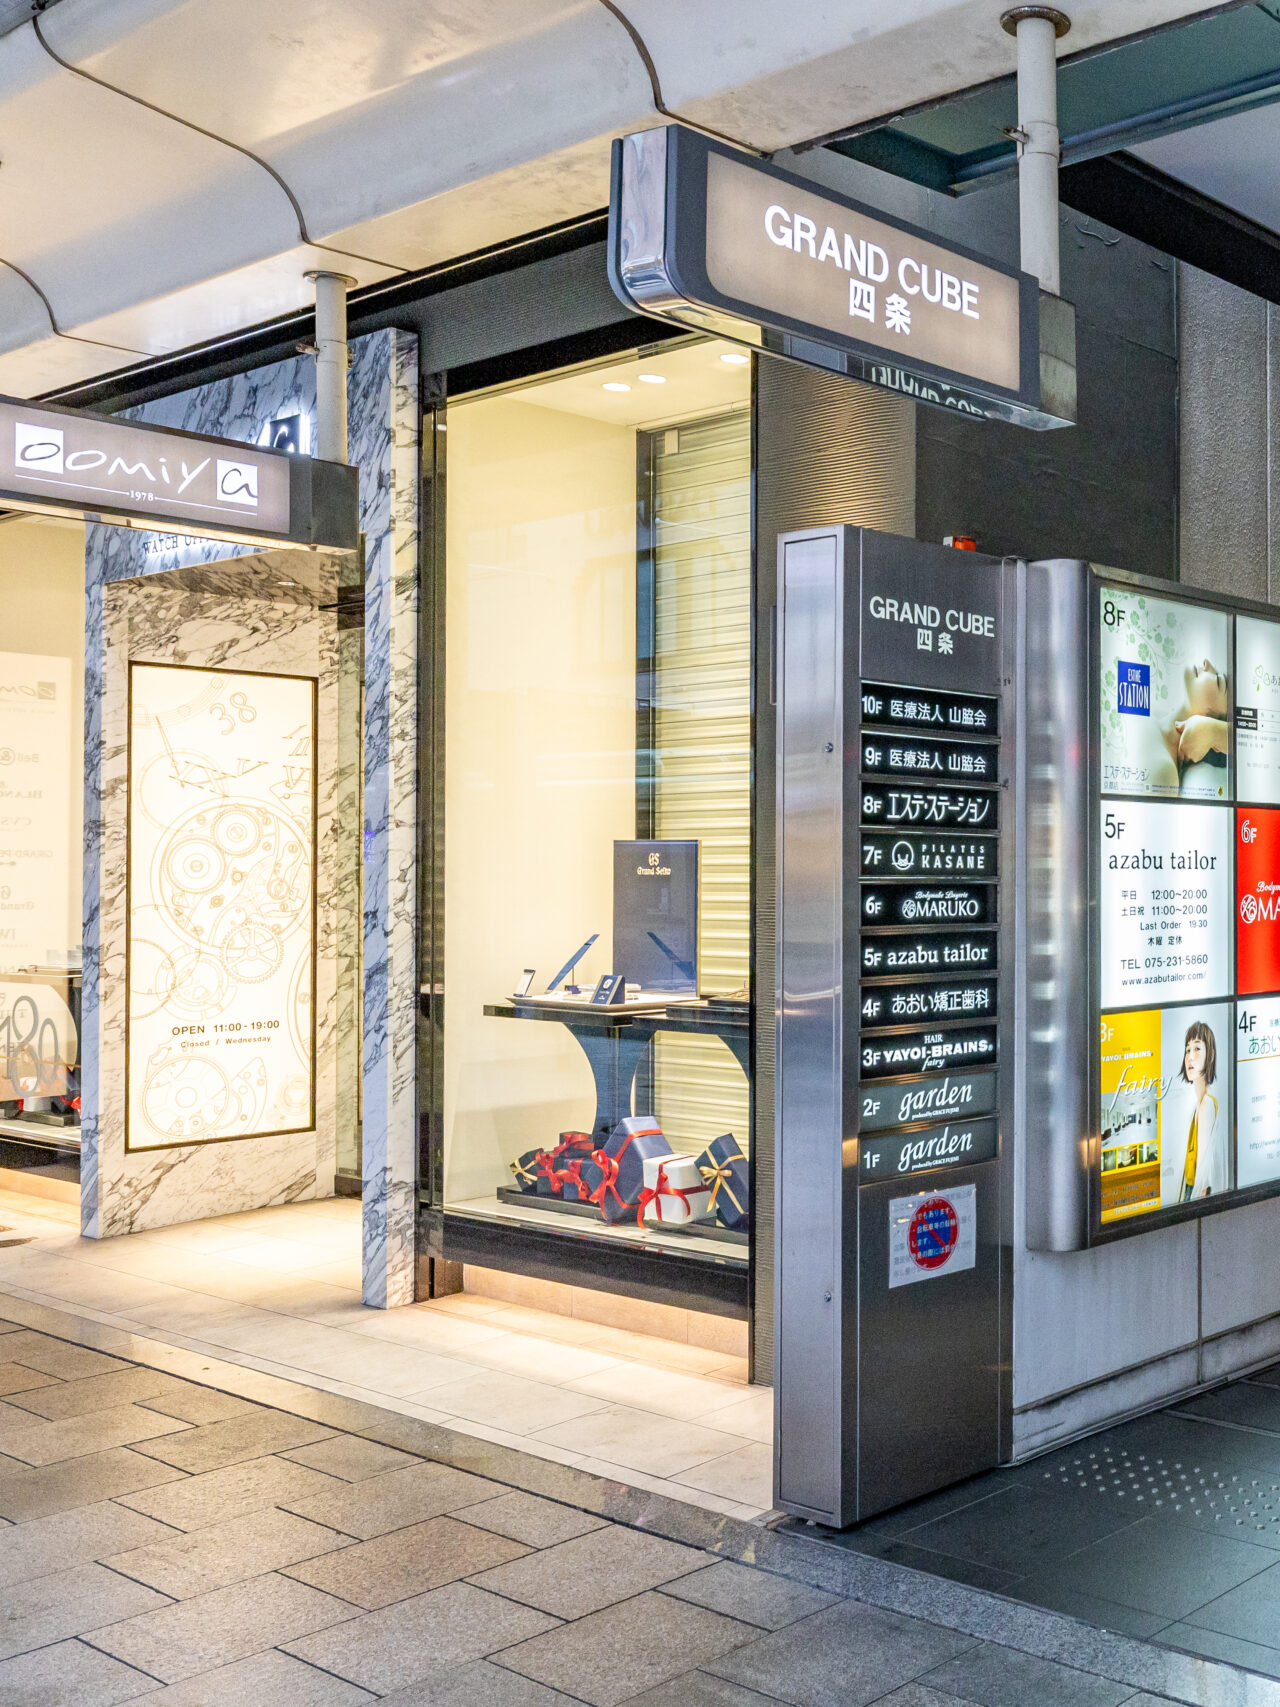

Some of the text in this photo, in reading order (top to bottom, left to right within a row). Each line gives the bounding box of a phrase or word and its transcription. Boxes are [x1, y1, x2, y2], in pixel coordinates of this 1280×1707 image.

[764, 204, 979, 320] GRAND CUBE
[848, 277, 912, 336] 四条
[129, 490, 154, 502] 1978
[142, 536, 178, 555] WATCH
[869, 596, 995, 637] GRAND CUBE
[1103, 600, 1125, 627] 8F
[917, 628, 954, 654] 四条
[1119, 682, 1149, 710] STATION
[861, 696, 987, 727] 10F 医療法人 山脇会
[865, 747, 986, 773] 9F 医療法人 山脇会
[863, 793, 989, 822] 8F エステ・ステーション
[1104, 813, 1125, 839] 5F
[1241, 820, 1258, 843] 6F
[863, 845, 882, 865] 7F
[921, 844, 985, 853] PILATES
[921, 855, 985, 869] KASANE
[1109, 849, 1217, 870] azabu tailor
[637, 866, 655, 875] Grand
[1121, 890, 1137, 900] 平日
[865, 897, 979, 917] 6F MARUKO
[1121, 906, 1145, 916] 土日祝
[1140, 921, 1181, 931] Last Order
[1168, 935, 1183, 945] 定休
[864, 944, 989, 967] 5F azabu tailor
[1121, 954, 1208, 970] TEL 075-231-5860
[862, 988, 989, 1017] 4F あおい矯正歯科
[171, 1020, 280, 1036] OPEN 11:00 19:00
[1100, 1022, 1115, 1042] 3F
[1238, 1011, 1257, 1034] 4F
[180, 1035, 271, 1048] Closed Wednesday
[924, 1034, 943, 1044] HAIR
[862, 1049, 881, 1067] 3F
[921, 1055, 945, 1071] fairy
[1109, 1065, 1173, 1112] fairy
[862, 1077, 973, 1121] 2F garden
[863, 1127, 973, 1171] 1F garden
